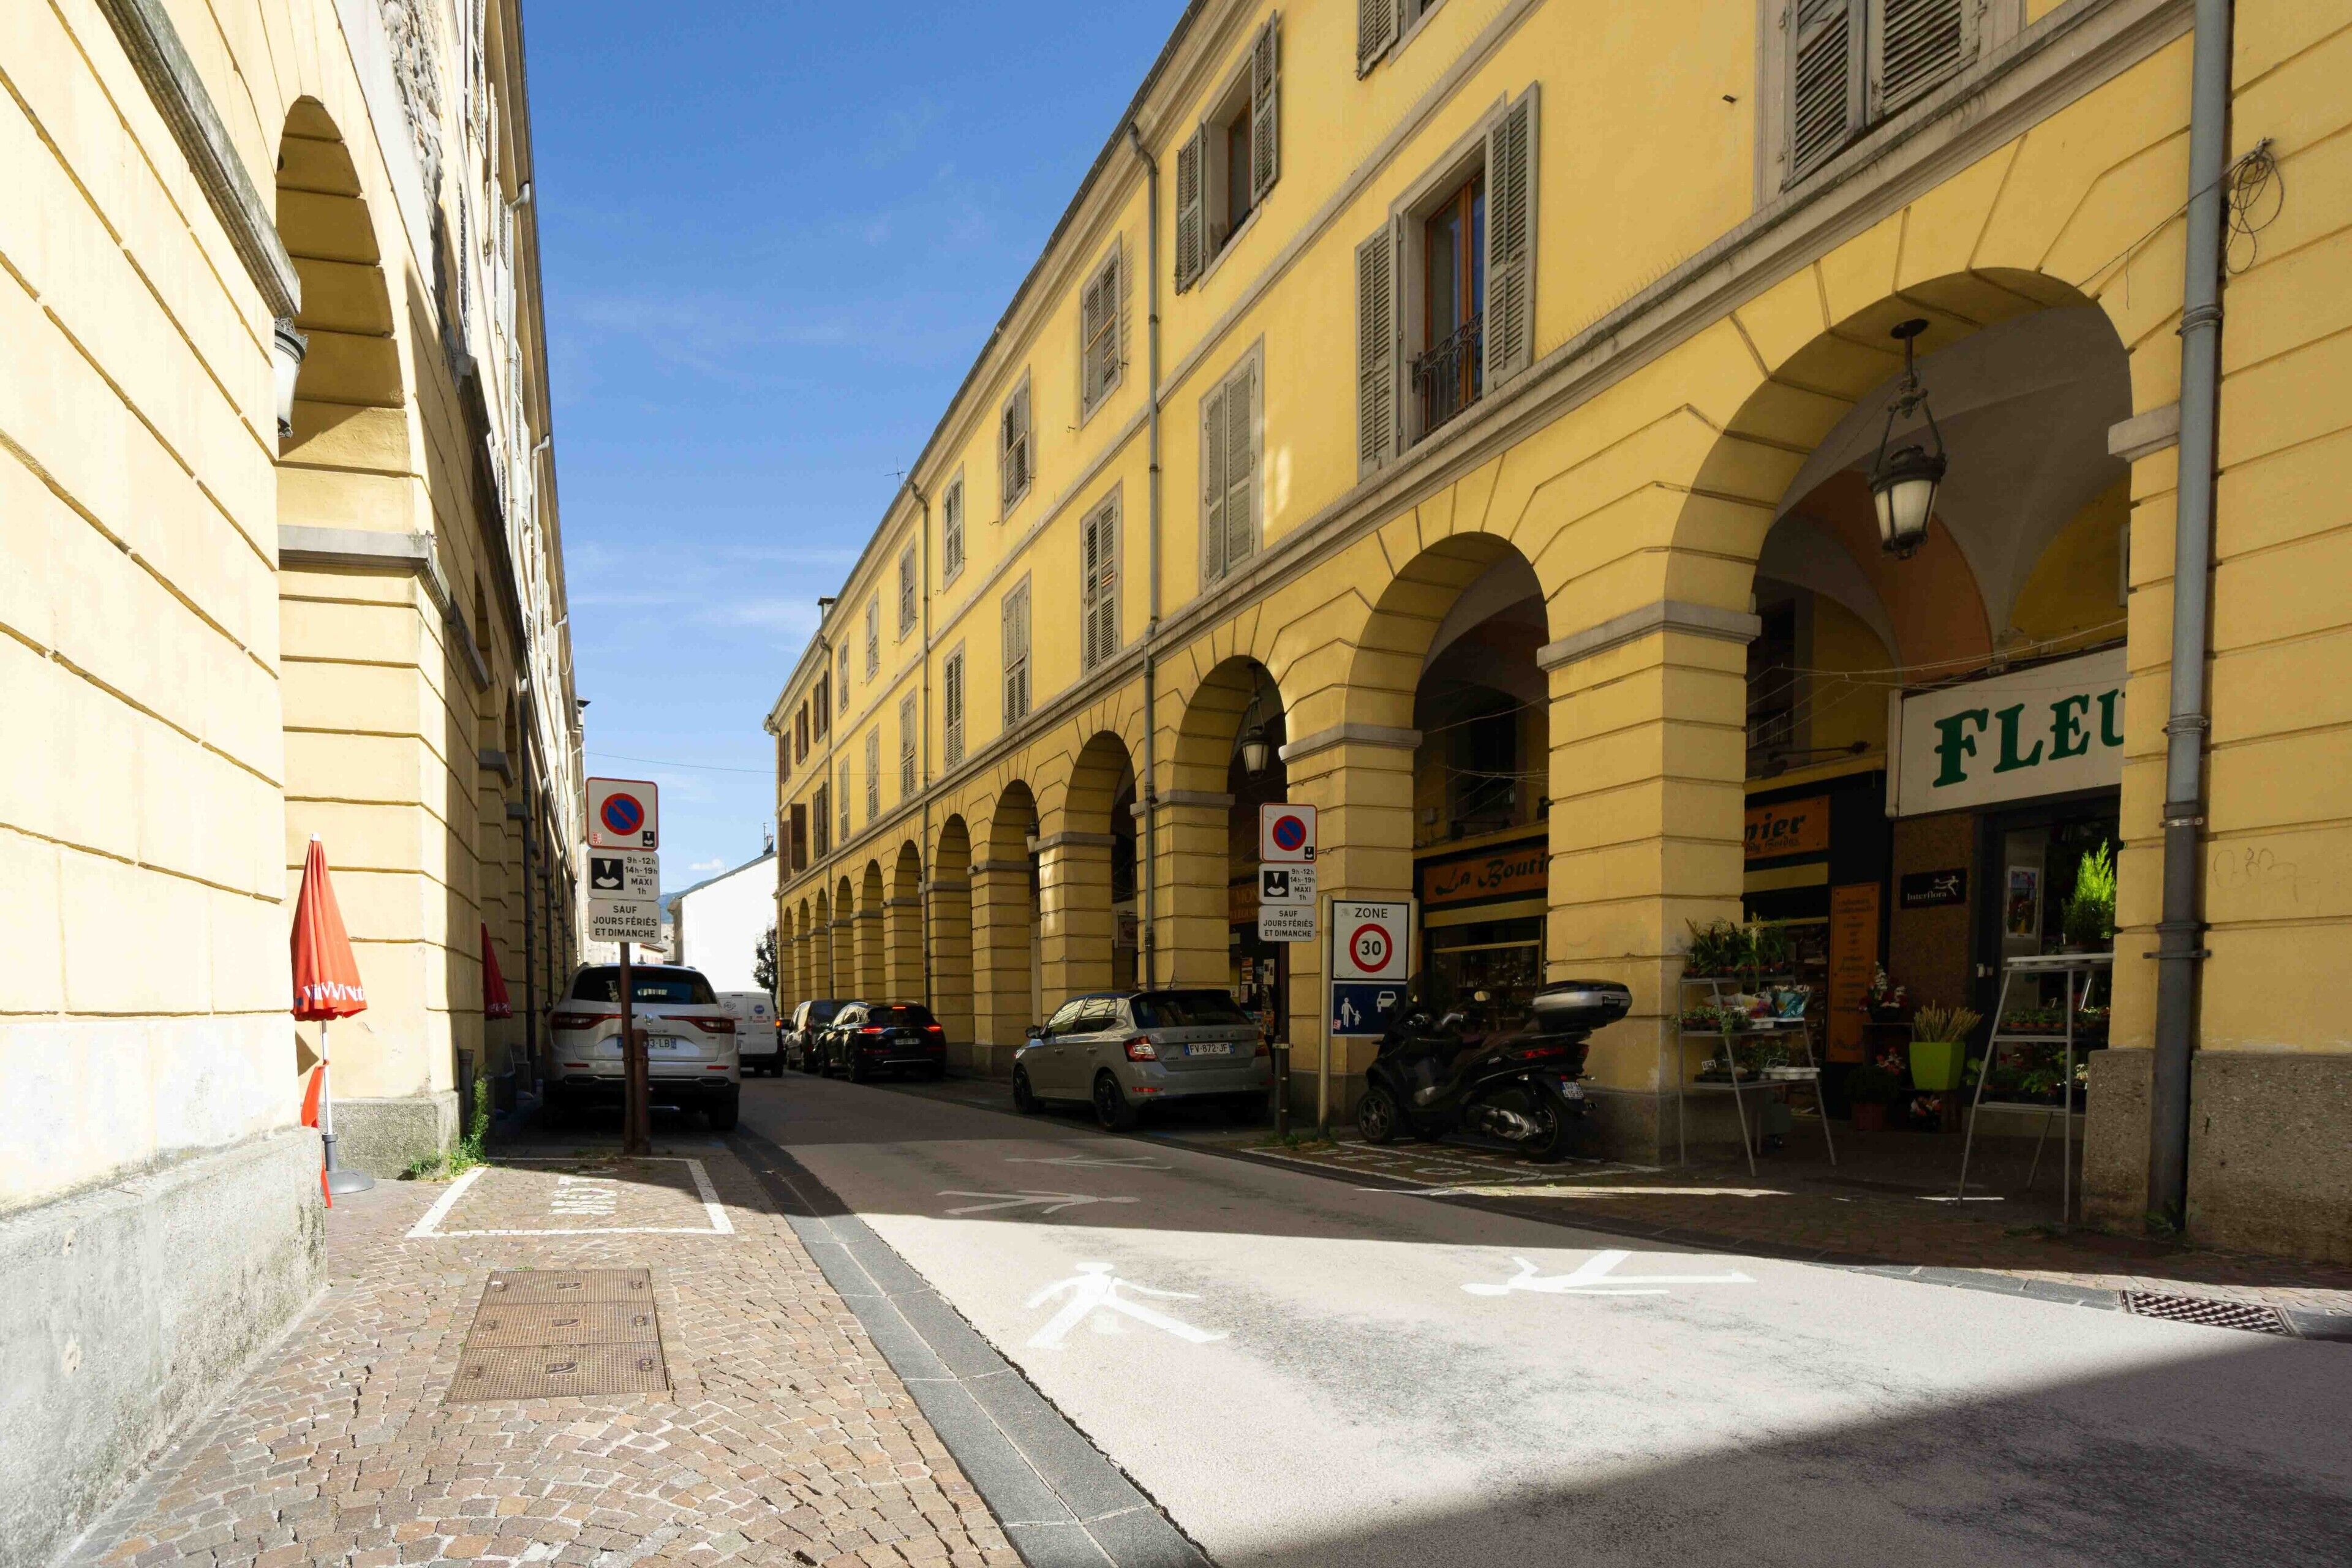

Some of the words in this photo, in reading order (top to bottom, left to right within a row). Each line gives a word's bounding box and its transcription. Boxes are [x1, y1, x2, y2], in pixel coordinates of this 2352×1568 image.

[1933, 688, 2125, 788] FLEU
[1435, 867, 1471, 895] La
[1477, 852, 1549, 888] Bouti
[1907, 890, 1947, 901] Interflora
[1355, 908, 1388, 918] ZONE
[593, 916, 624, 925] JOURS
[625, 916, 657, 926] FÉRIÉS
[1288, 919, 1313, 927] FÉRIÉS
[608, 929, 655, 938] DIMANCHE
[1362, 940, 1381, 956] 30
[1189, 1043, 1228, 1053] FV-872-JF
